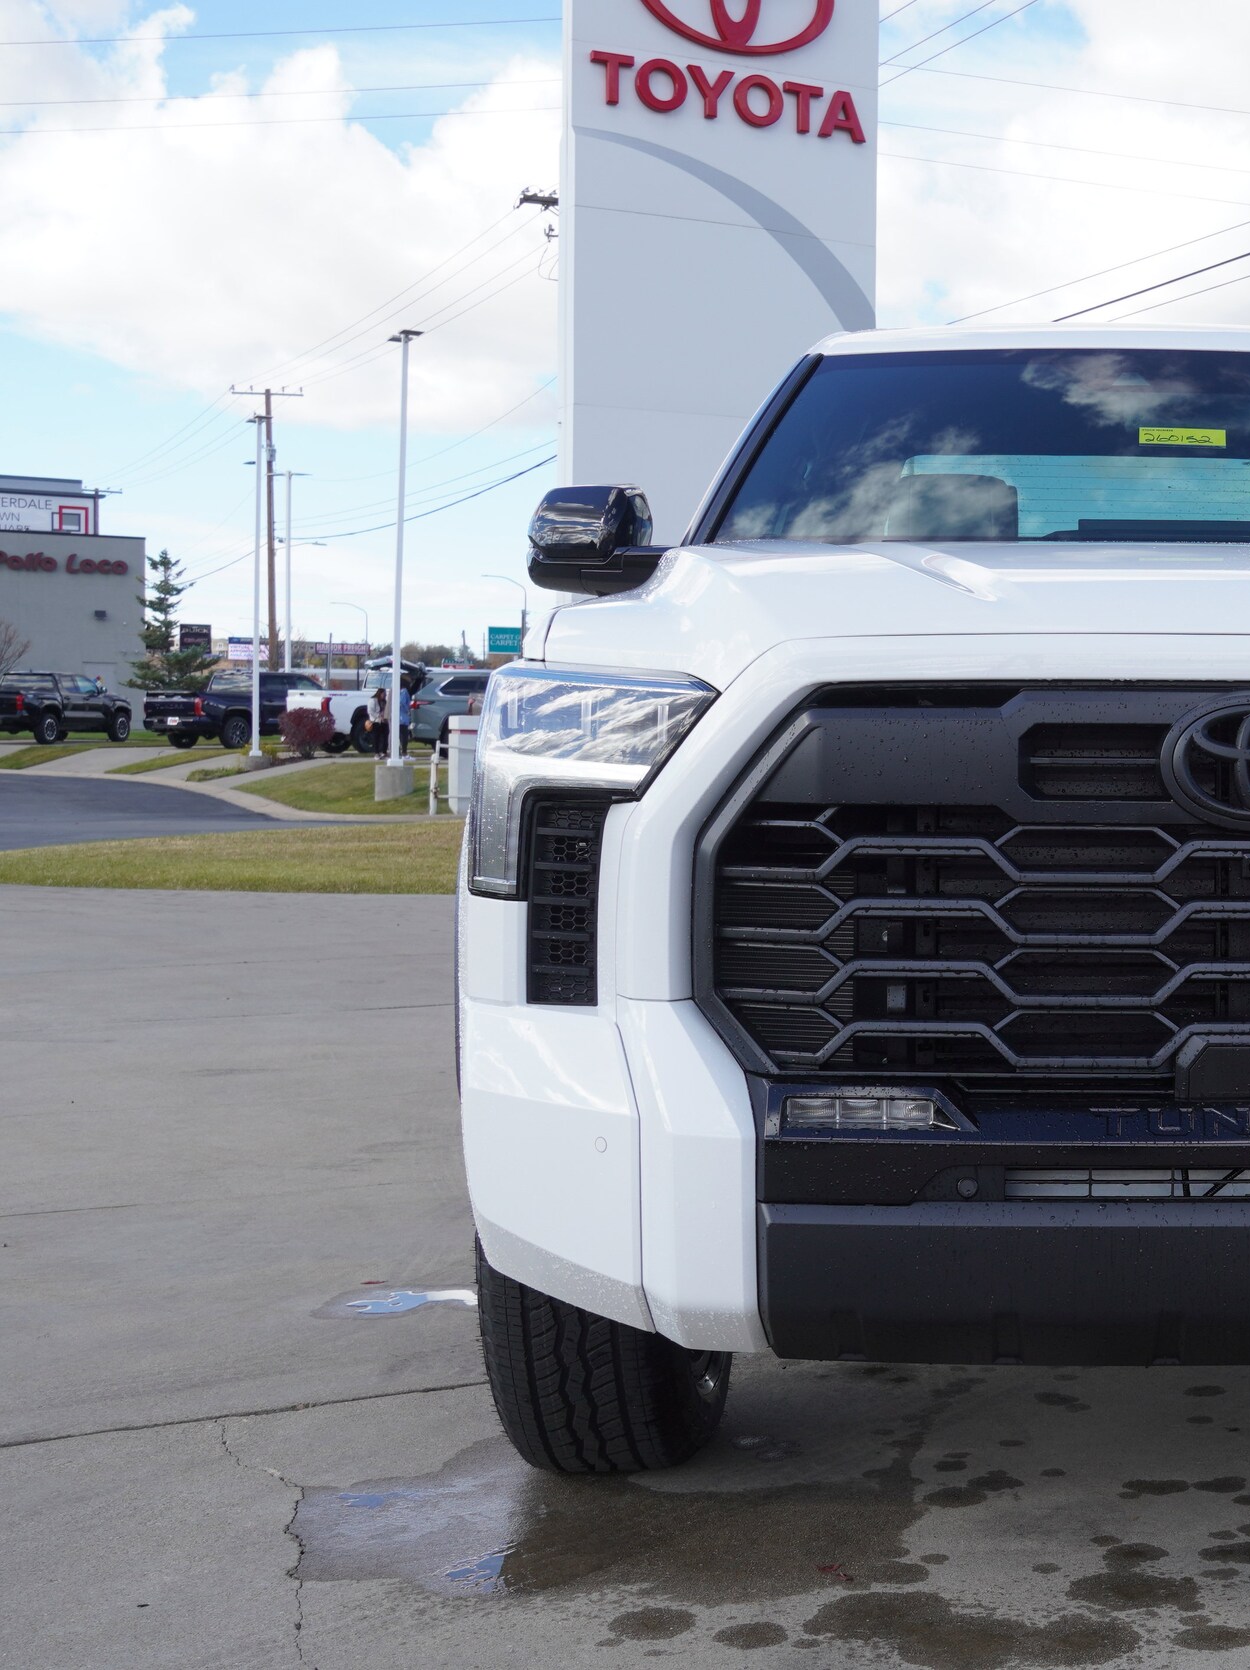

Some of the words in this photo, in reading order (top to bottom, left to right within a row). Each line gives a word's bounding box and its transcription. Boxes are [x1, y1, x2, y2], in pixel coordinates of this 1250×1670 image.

[590, 50, 866, 144] TOYOTA
[1144, 432, 1213, 444] 260152
[66, 553, 128, 575] Loco
